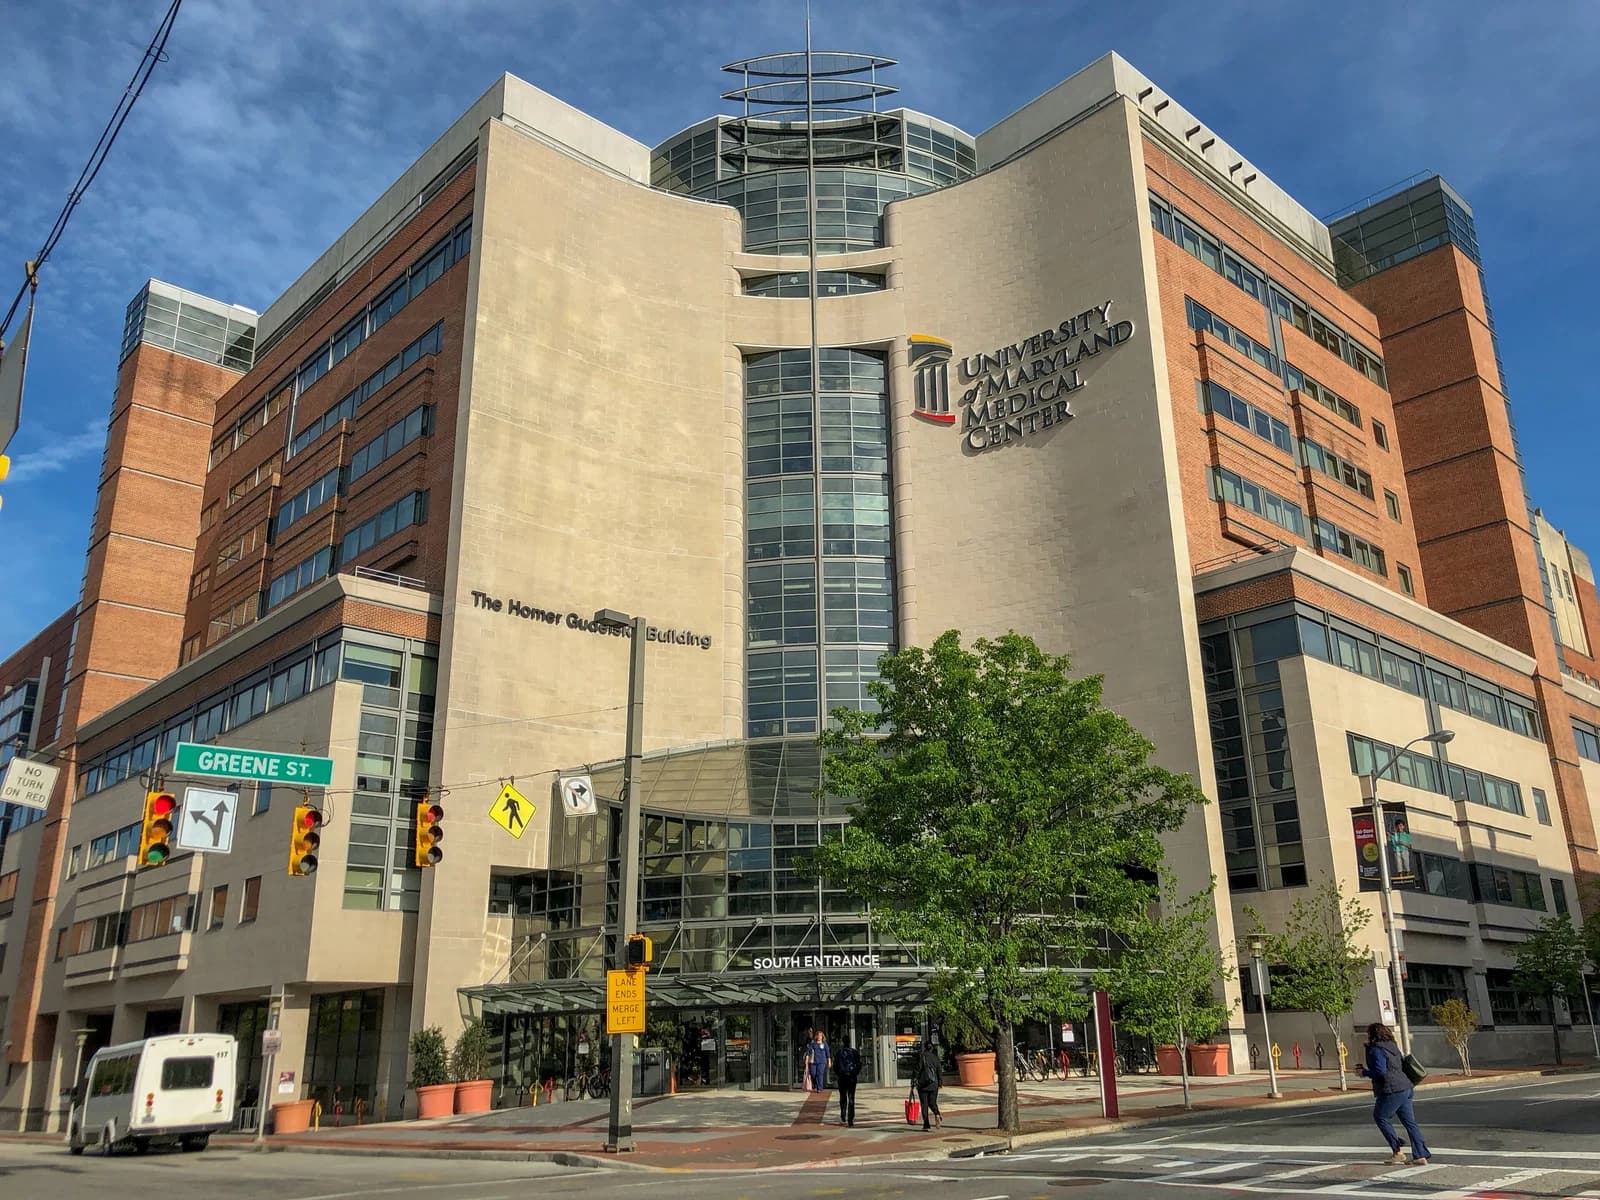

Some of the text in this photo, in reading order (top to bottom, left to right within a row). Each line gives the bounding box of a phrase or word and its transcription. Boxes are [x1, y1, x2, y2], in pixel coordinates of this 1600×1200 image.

[961, 300, 1114, 378] UNIVERSITY
[963, 320, 1135, 403] of MARYLAND
[966, 368, 1087, 428] MEDICAL
[966, 400, 1076, 450] CENTER
[471, 590, 502, 612] The
[508, 599, 562, 625] Homer
[646, 626, 711, 649] Building
[25, 766, 42, 777] NO
[198, 751, 312, 778] GREENE ST.
[17, 777, 44, 790] TURN
[5, 787, 46, 803] ON RED
[753, 954, 880, 969] SOUTH ENTRANCE
[615, 977, 637, 987] LANE
[615, 990, 637, 999] ENDS
[612, 1004, 640, 1013] MERGE
[616, 1016, 637, 1025] LEFT
[216, 1051, 229, 1059] 117
